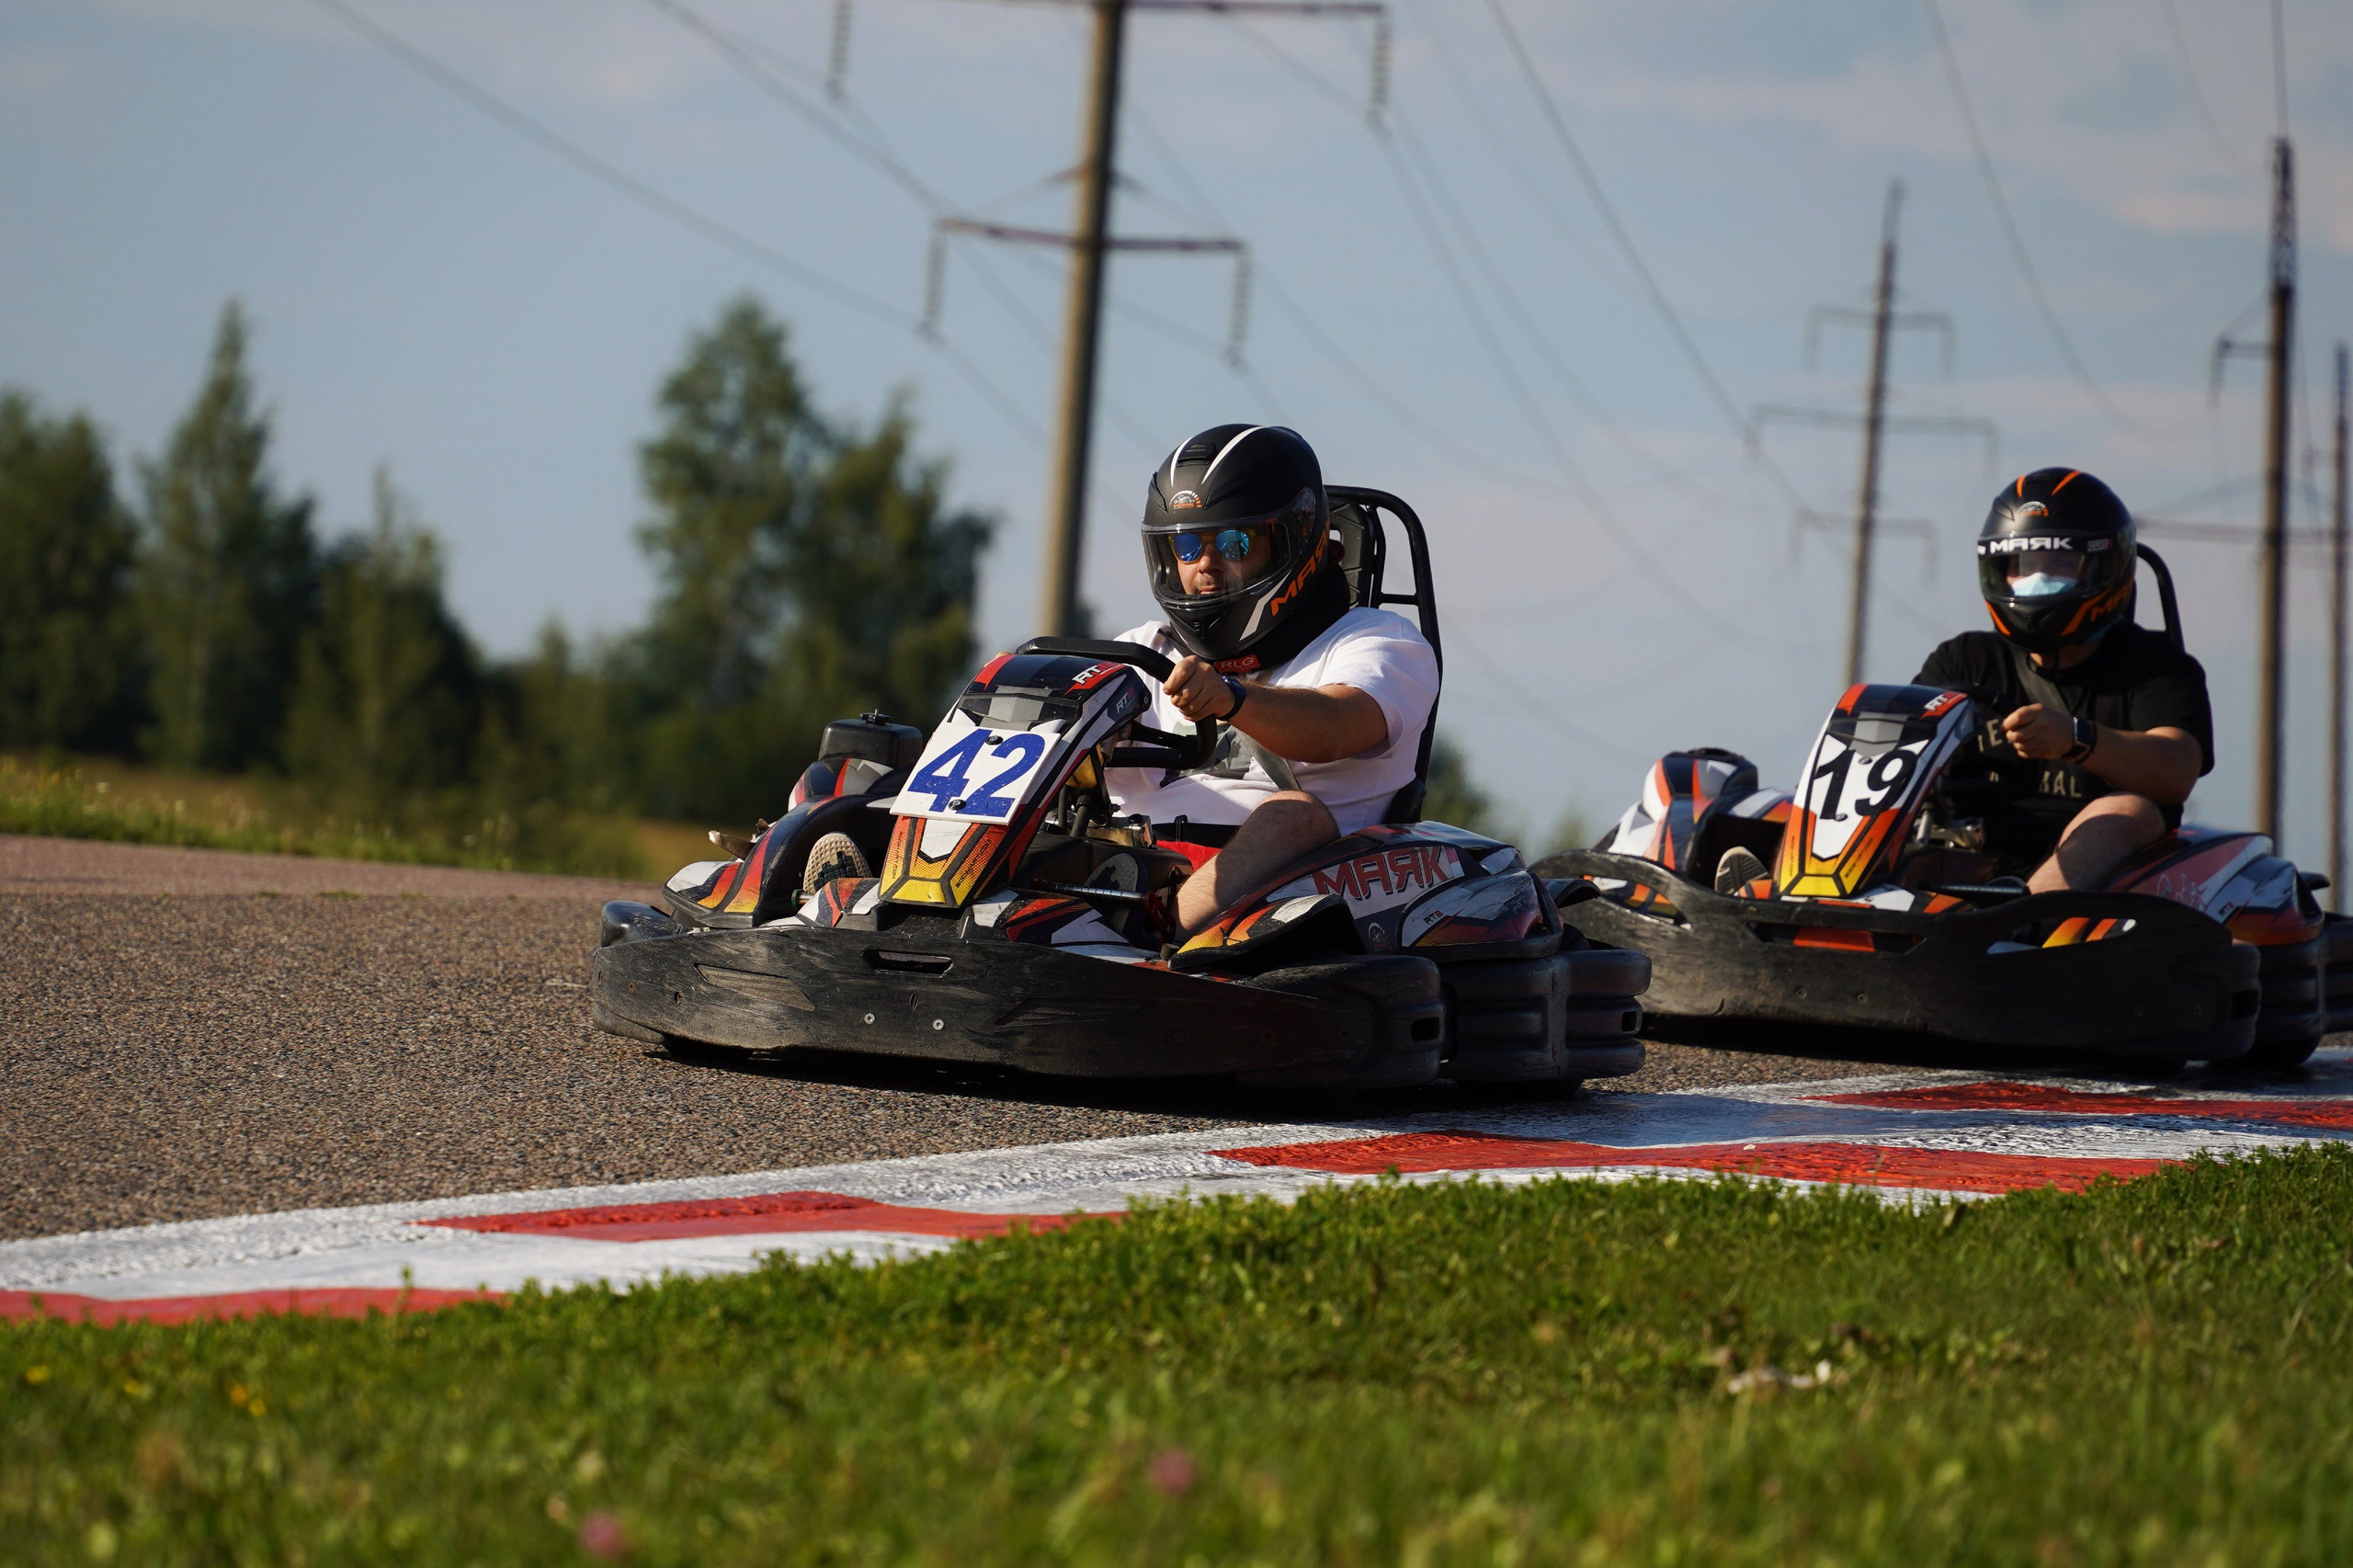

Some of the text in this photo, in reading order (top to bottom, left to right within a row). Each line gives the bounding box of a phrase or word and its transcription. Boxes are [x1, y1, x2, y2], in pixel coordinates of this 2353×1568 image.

[1989, 537, 2074, 554] МАЯК
[907, 728, 1046, 818] 42
[1813, 749, 1918, 820] 19
[1312, 846, 1449, 901] МАЯК
[1423, 910, 1444, 926] RT8
